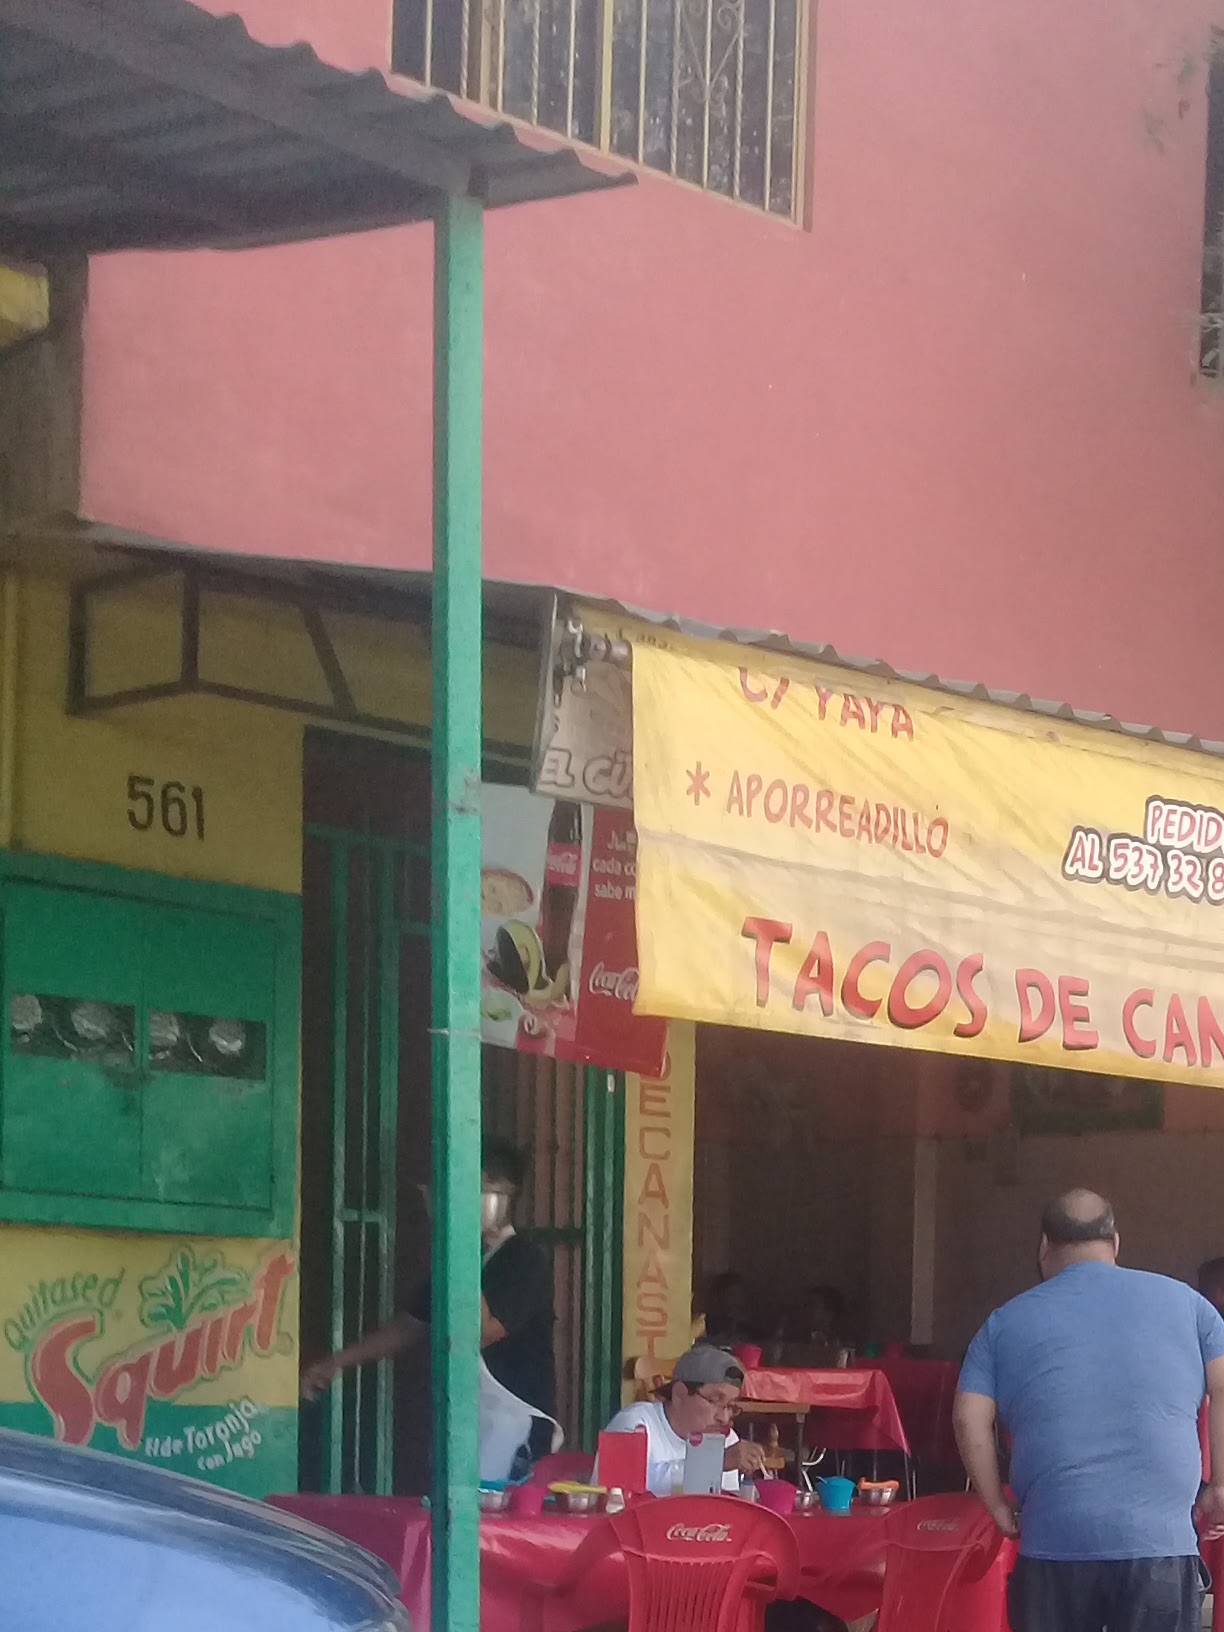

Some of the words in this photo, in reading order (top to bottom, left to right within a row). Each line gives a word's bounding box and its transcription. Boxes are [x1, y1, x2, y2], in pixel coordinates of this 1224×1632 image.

[127, 774, 205, 840] 561
[727, 769, 949, 858] APORREADILLO
[1064, 830, 1103, 878] AL
[1110, 838, 1164, 890] 537
[1167, 850, 1204, 898] 32
[741, 916, 988, 1038] TACOS
[1015, 968, 1099, 1050] DE
[636, 1127, 671, 1359] CANAST
[183, 1396, 259, 1454] Toronja
